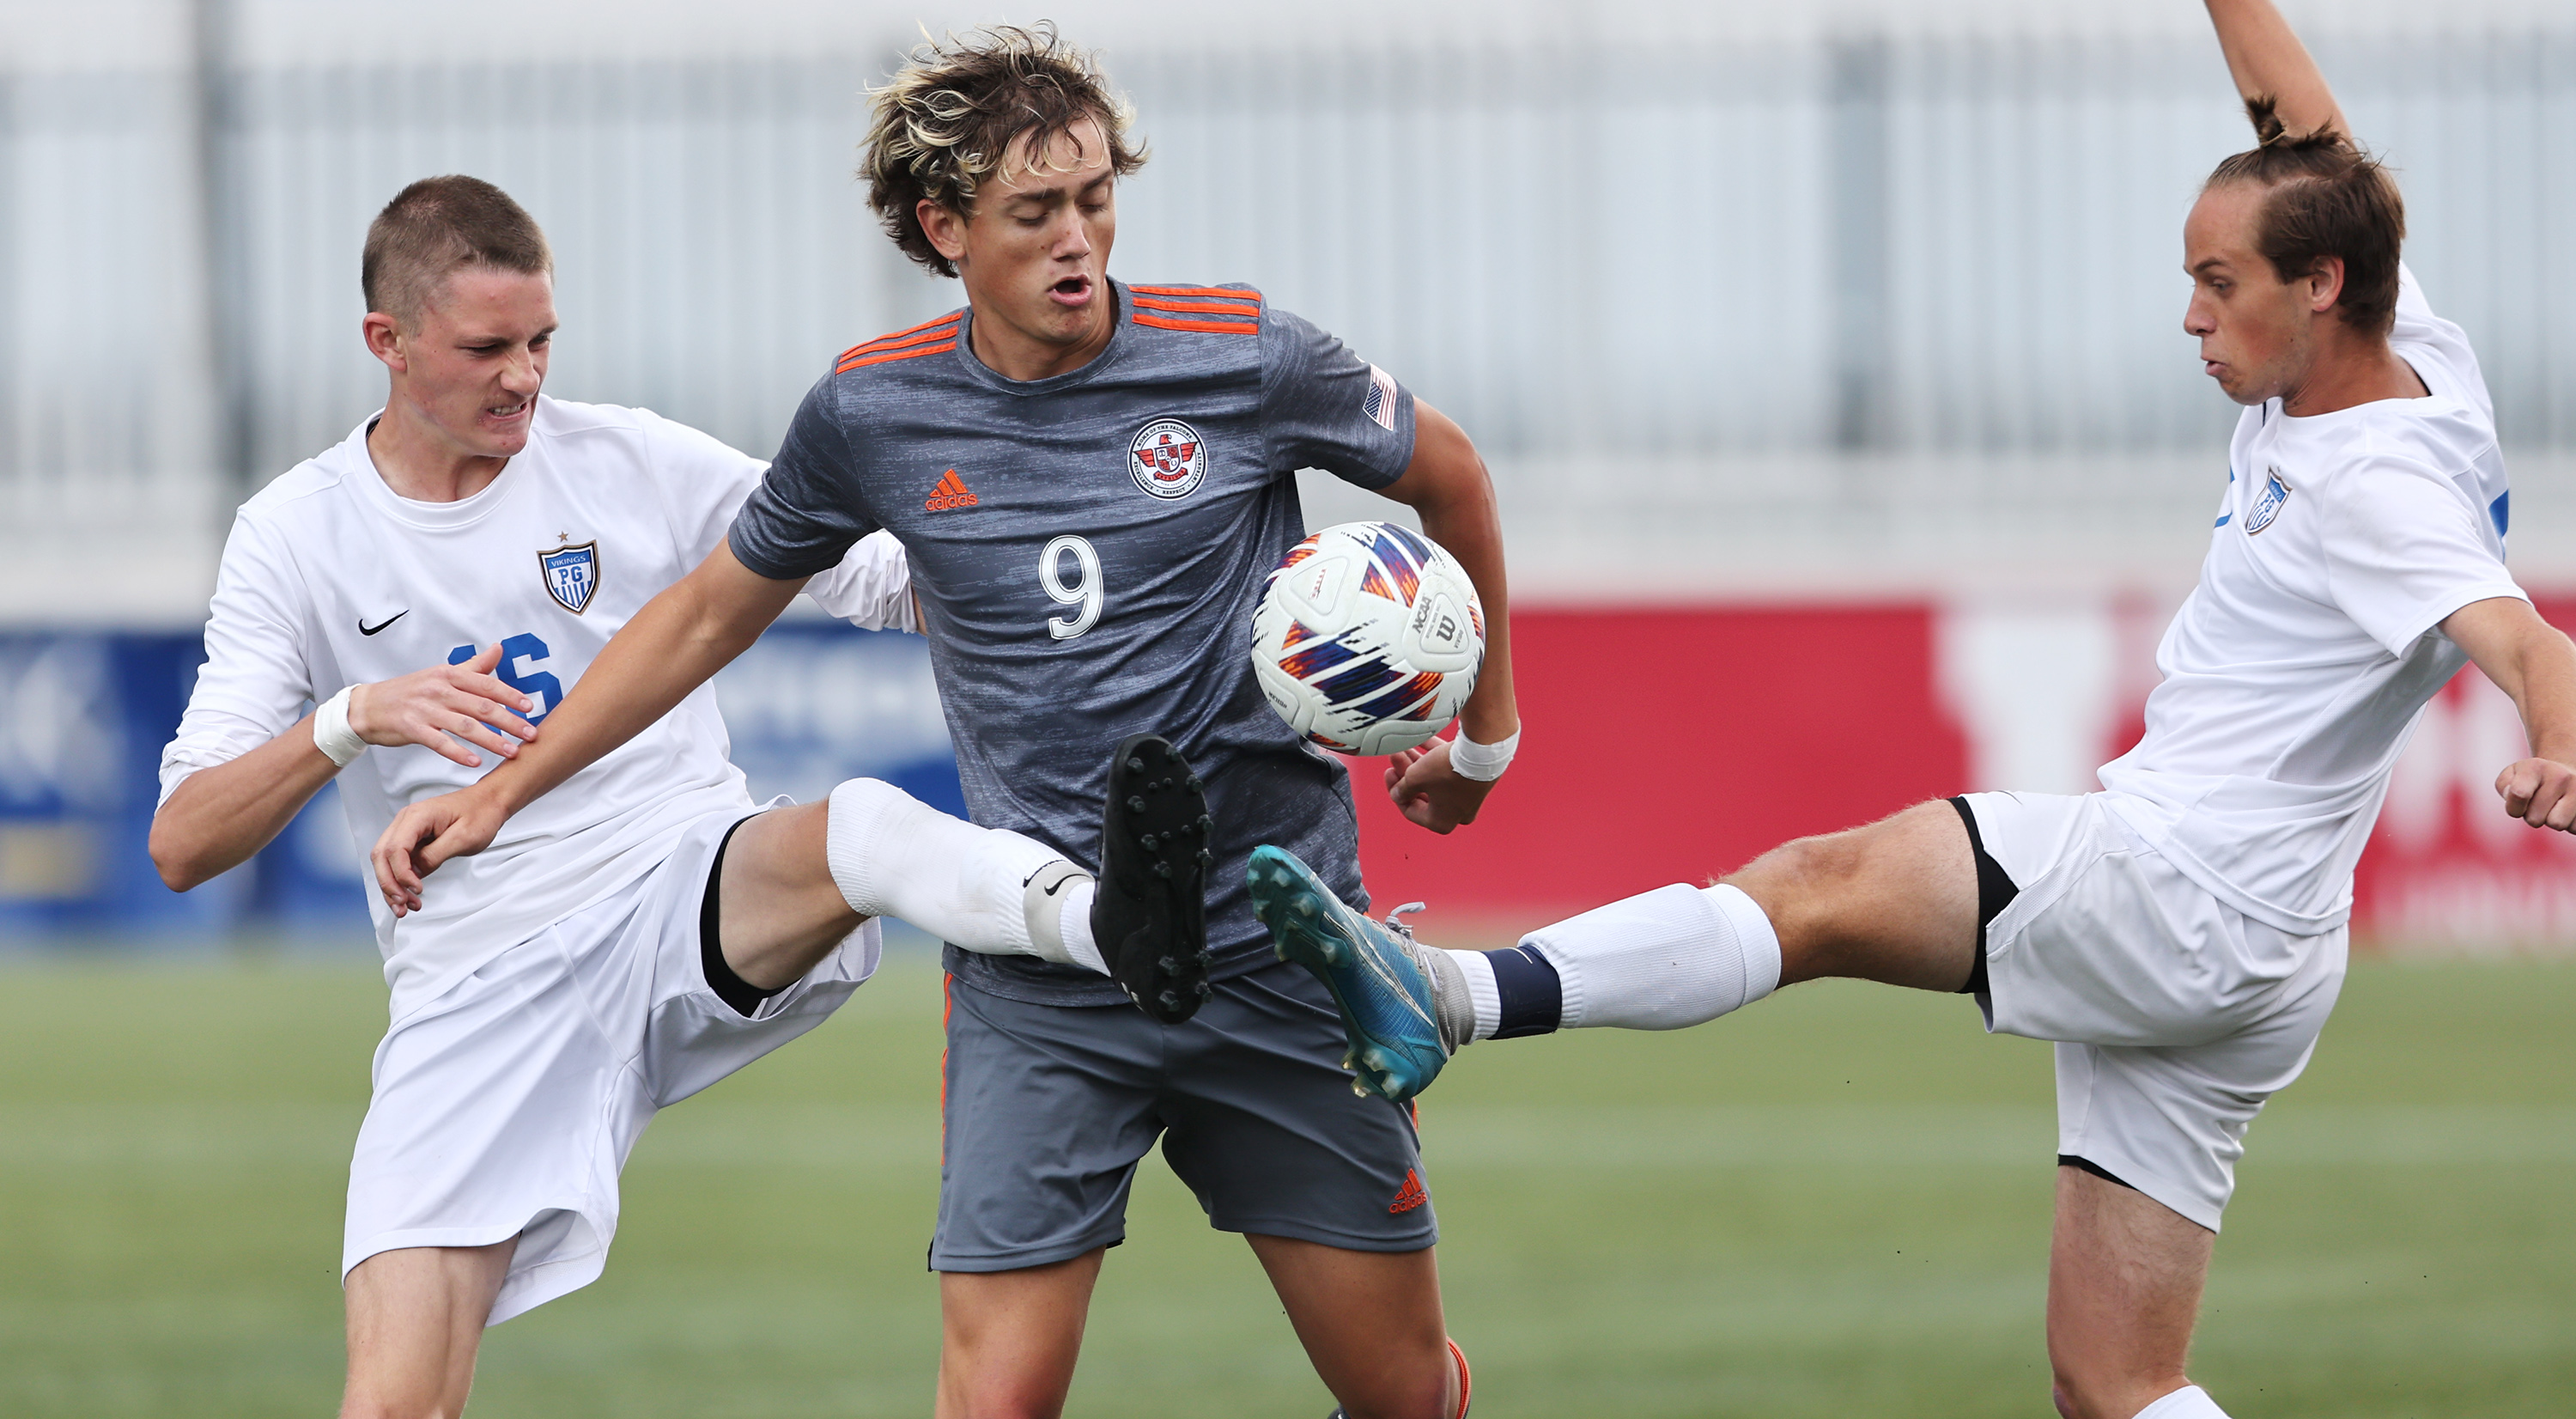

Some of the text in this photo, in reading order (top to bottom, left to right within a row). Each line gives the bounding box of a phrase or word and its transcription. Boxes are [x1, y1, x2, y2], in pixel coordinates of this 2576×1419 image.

[1137, 432, 1149, 447] HOME
[1170, 425, 1192, 439] FALCONS
[926, 493, 979, 511] adidas
[2260, 493, 2275, 513] PG
[550, 555, 586, 568] VIKINGS
[558, 565, 583, 586] PG
[1038, 534, 1103, 640] 9
[1412, 595, 1432, 634] NCAA
[1388, 1191, 1427, 1214] adidas
